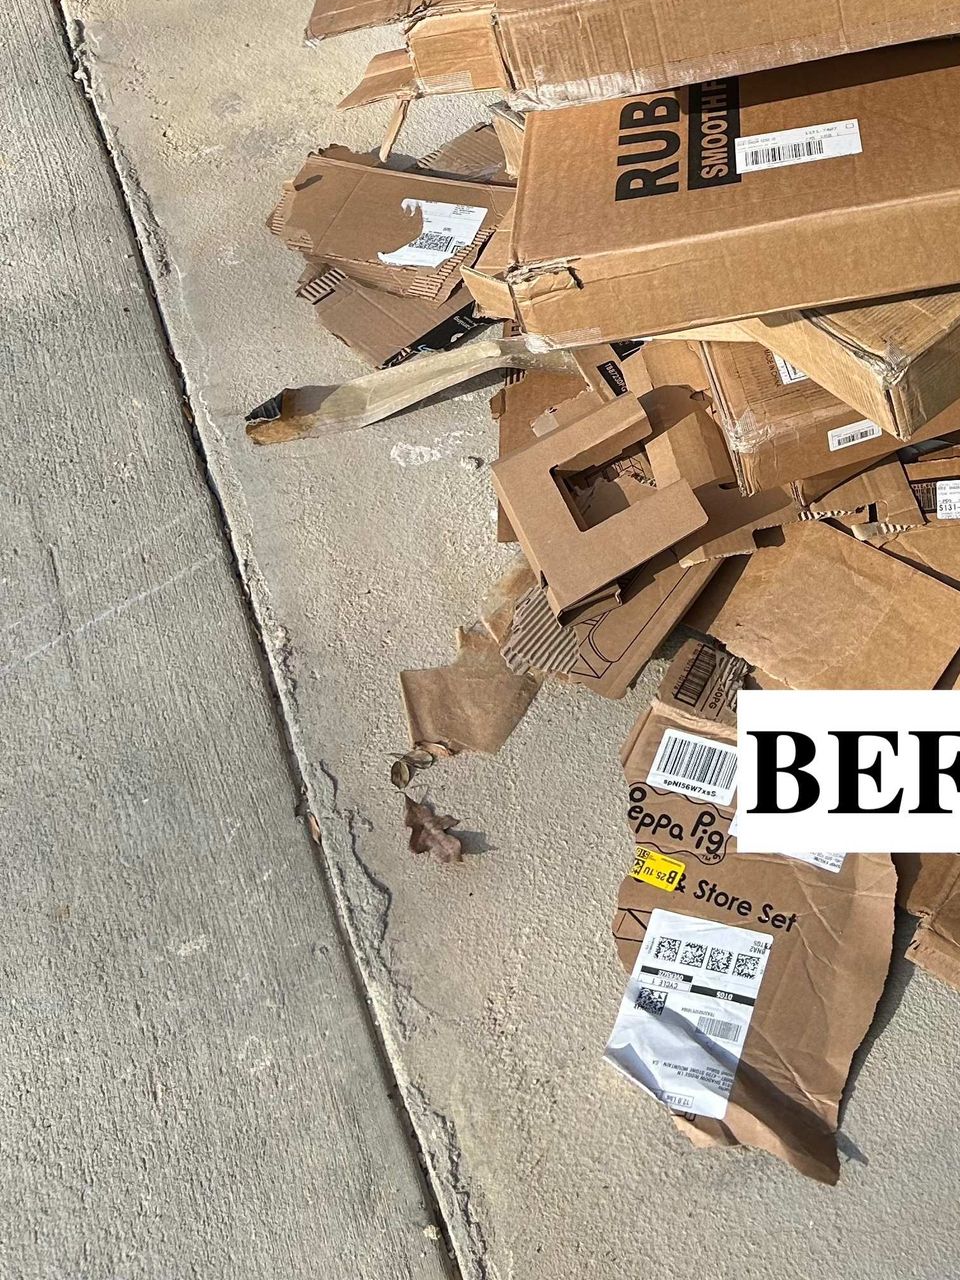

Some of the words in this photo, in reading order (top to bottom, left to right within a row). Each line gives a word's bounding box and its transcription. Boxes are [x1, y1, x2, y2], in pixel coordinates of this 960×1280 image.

[701, 94, 729, 181] SMOOTH
[691, 810, 725, 854] Pig
[666, 869, 678, 885] B
[694, 880, 753, 920] Store
[758, 903, 797, 934] Set
[658, 979, 678, 989] CYCLE
